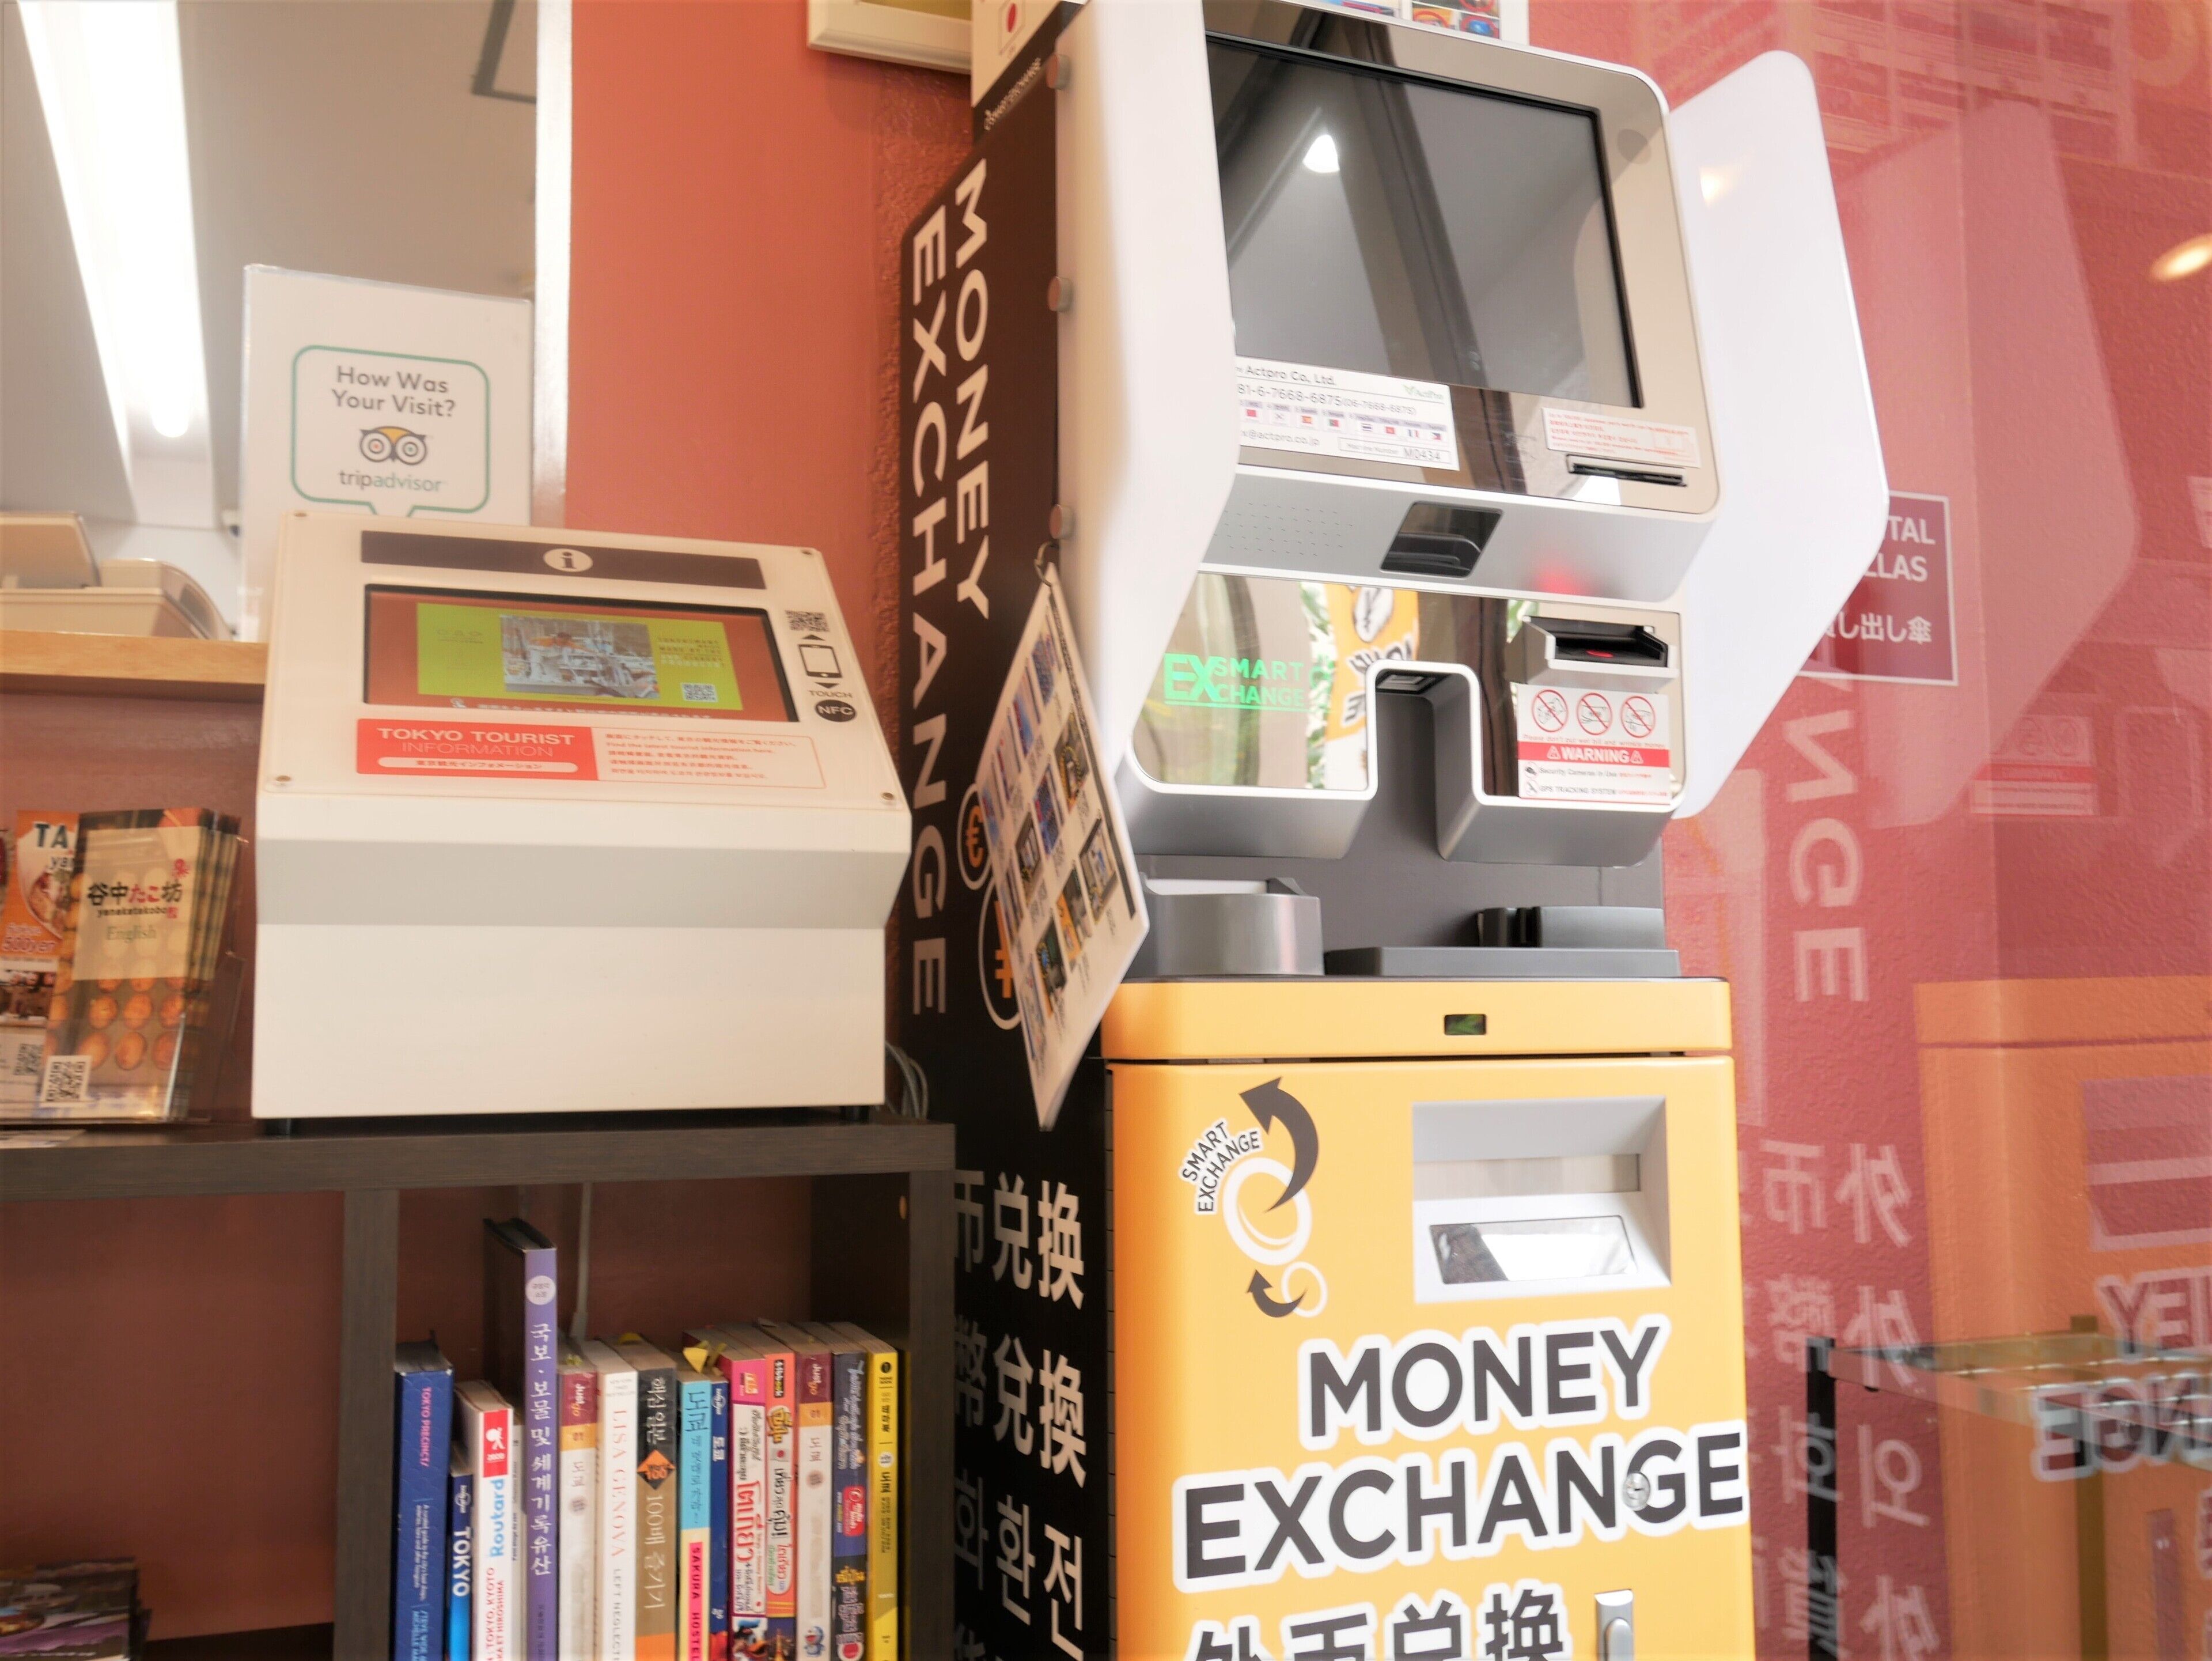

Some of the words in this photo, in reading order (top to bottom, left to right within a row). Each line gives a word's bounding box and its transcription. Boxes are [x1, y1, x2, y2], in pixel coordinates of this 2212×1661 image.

[337, 365, 390, 388] How
[396, 371, 448, 394] Was
[955, 158, 988, 619] MONEY
[332, 389, 385, 411] Your
[391, 395, 456, 417] Visit?
[338, 470, 442, 492] tripadvisor
[912, 205, 947, 1015] EXCHANGE
[1213, 656, 1304, 680] SMART
[808, 690, 853, 698] TOUCH
[817, 705, 853, 716] NFC
[377, 728, 463, 742] TOKYO
[470, 731, 575, 745] TOURIST
[403, 741, 554, 758] INFORMATION
[1560, 746, 1630, 763] WARNING
[87, 881, 183, 906] 谷中たこ坊
[1182, 1121, 1229, 1182] SMART
[1198, 1130, 1260, 1212] EXCHANGE
[1309, 1325, 1660, 1437] MONEY
[421, 1386, 431, 1418] TOKYO
[612, 1410, 627, 1459] LISA
[490, 1478, 505, 1557] Routard
[612, 1468, 626, 1557] GENOVA
[645, 1496, 665, 1545] 100배
[1185, 1431, 1744, 1579] EXCHANGE
[452, 1526, 471, 1597] TOKYO
[692, 1547, 701, 1600] SAKURA
[613, 1568, 622, 1596] LEFT
